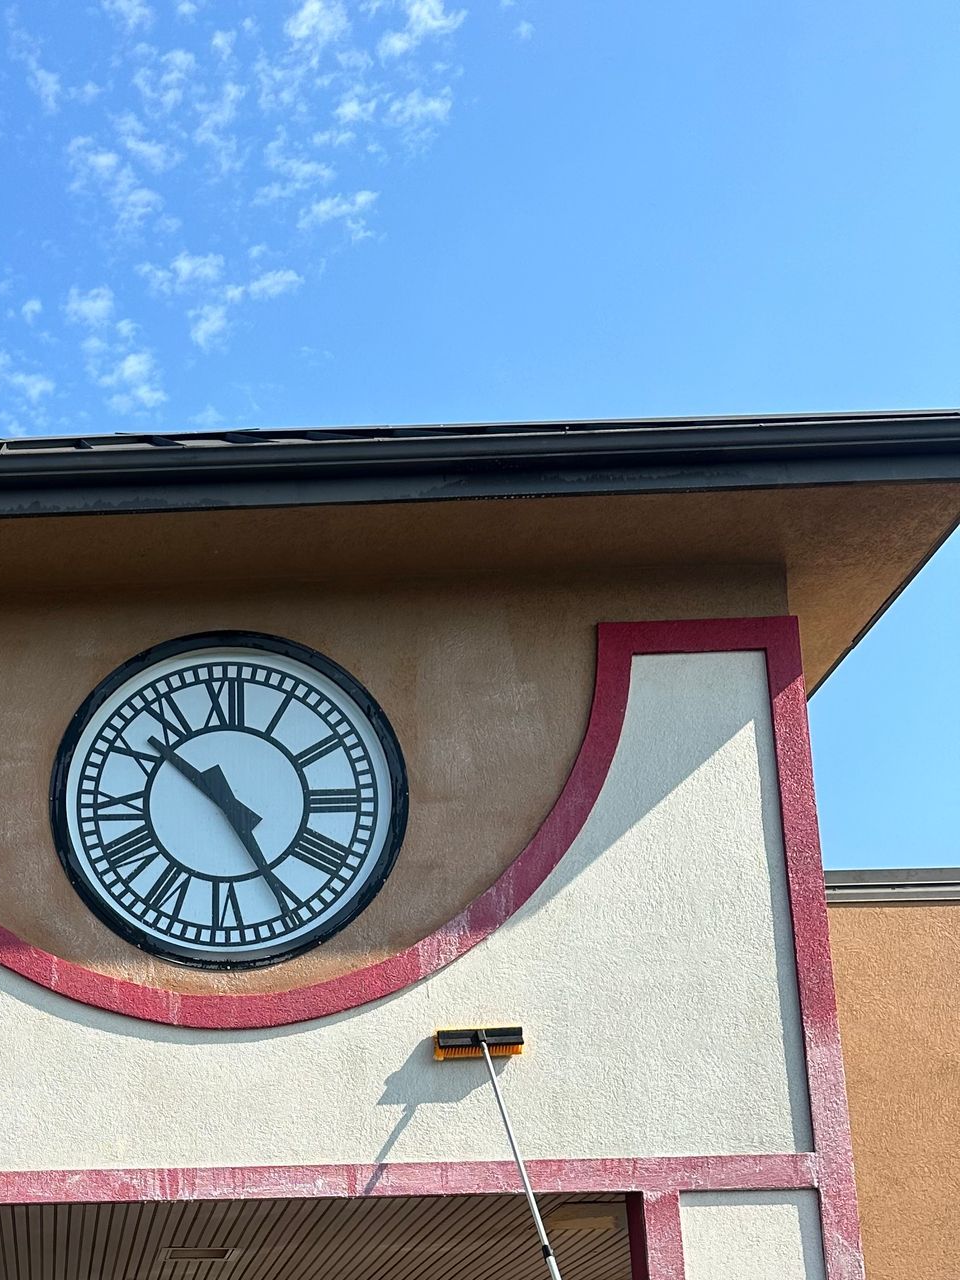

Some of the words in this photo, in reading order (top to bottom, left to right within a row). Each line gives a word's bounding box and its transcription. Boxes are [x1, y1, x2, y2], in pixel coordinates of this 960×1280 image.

[147, 694, 193, 746] XI
[205, 680, 245, 728] XII
[266, 693, 294, 737] I
[111, 734, 161, 776] X
[295, 734, 343, 768] II
[97, 790, 146, 822] IX
[309, 788, 358, 814] III
[105, 824, 160, 884] VIII
[143, 864, 191, 918] VII
[212, 880, 244, 928] VI
